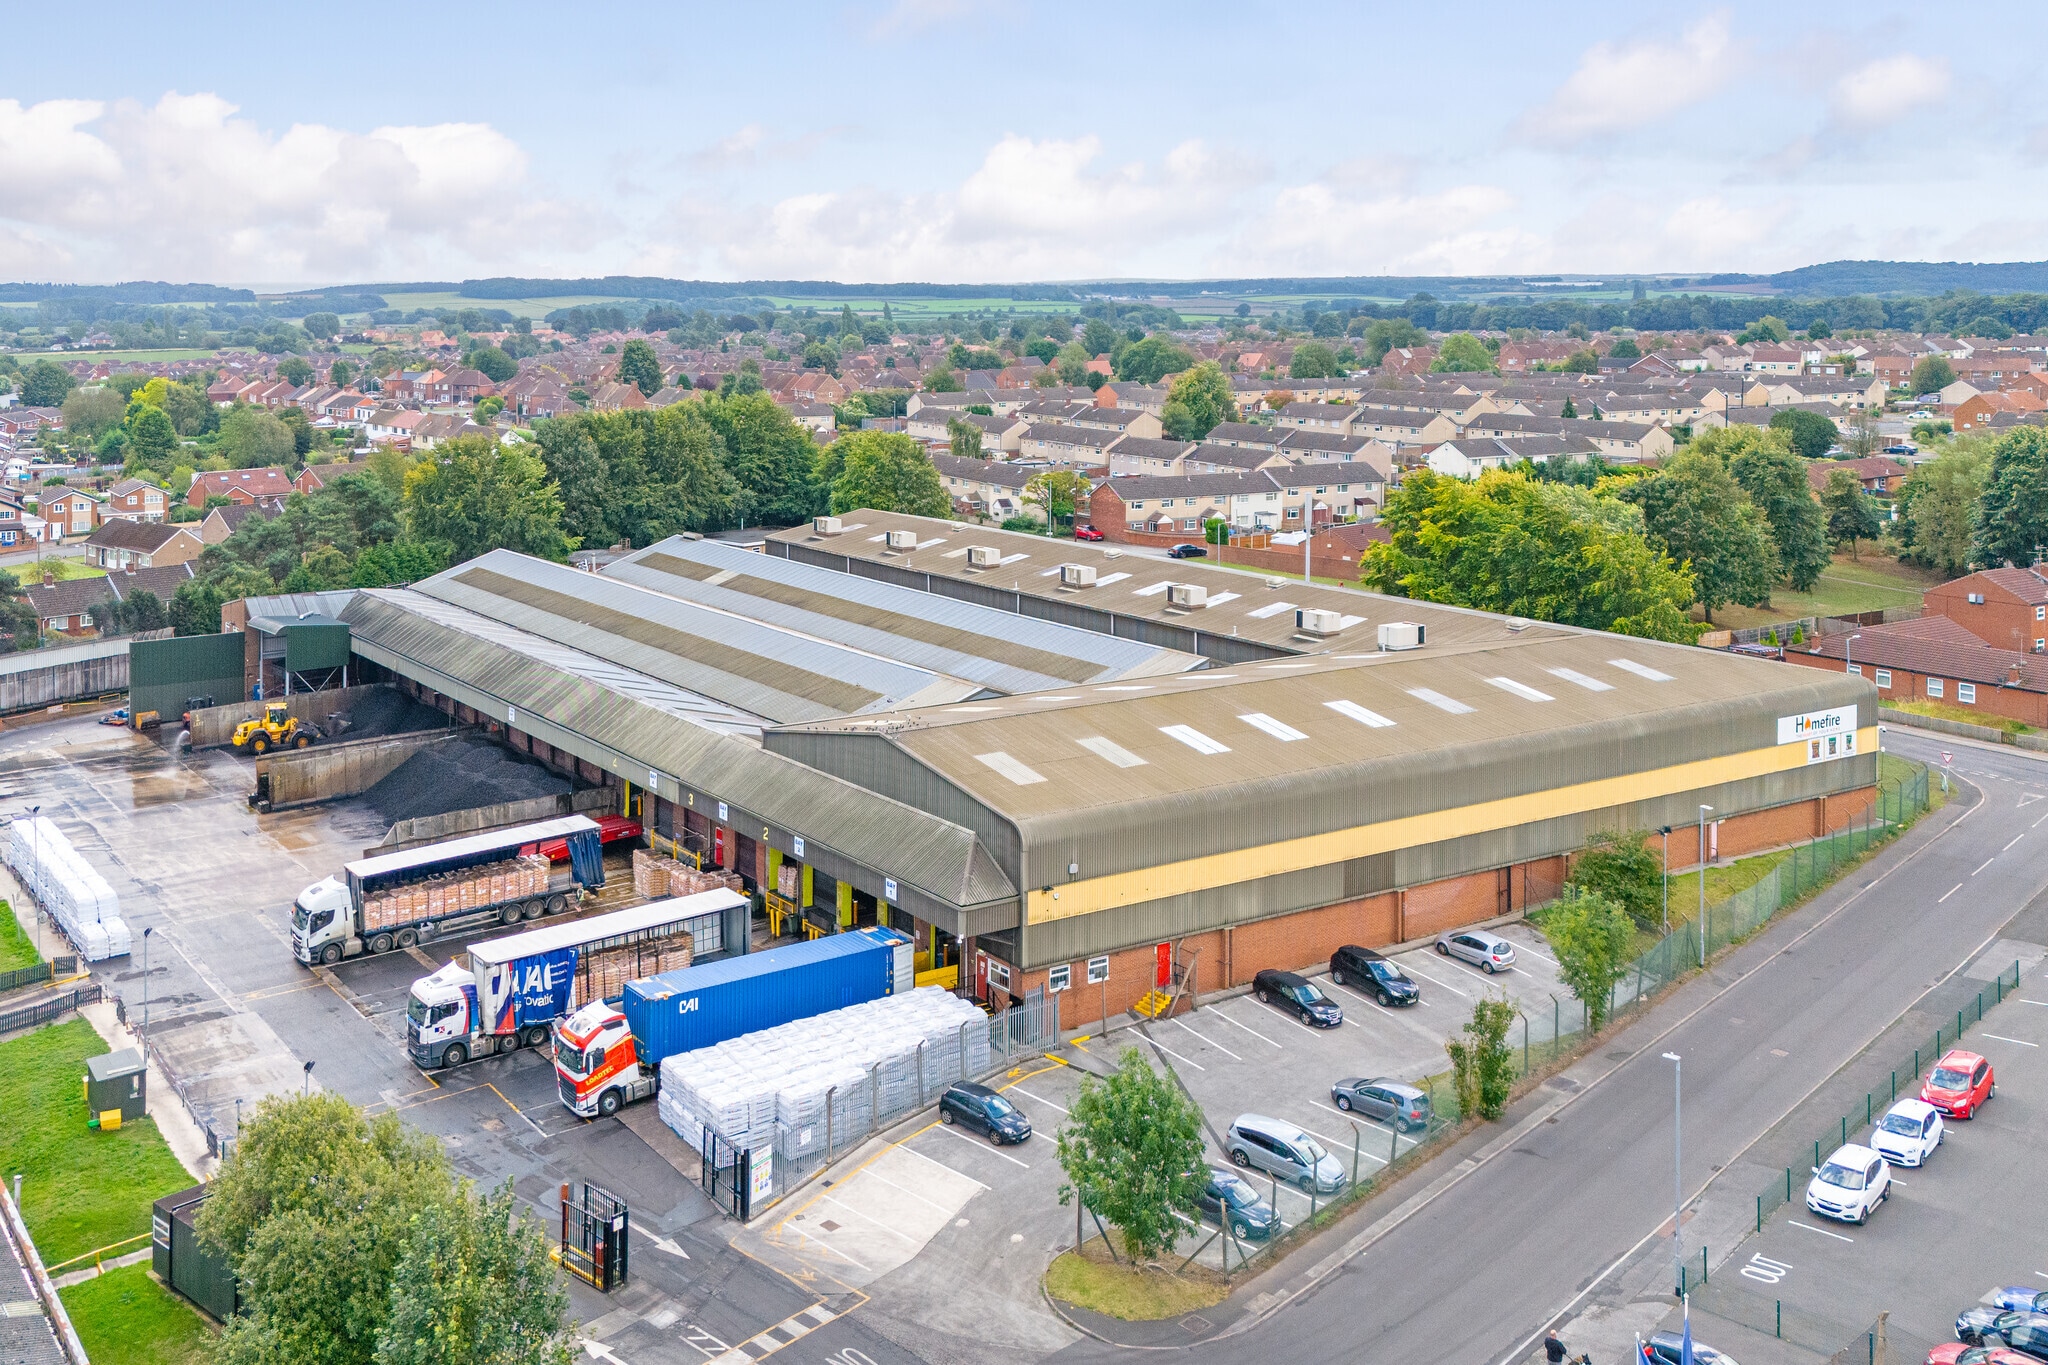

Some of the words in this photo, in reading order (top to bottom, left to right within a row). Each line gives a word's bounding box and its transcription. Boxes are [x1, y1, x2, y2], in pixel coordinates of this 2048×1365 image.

[688, 792, 695, 806] 3
[762, 826, 769, 840] 2
[679, 997, 699, 1014] CAI
[585, 1065, 615, 1086] LOADTEC
[1740, 1252, 1793, 1284] OUT
